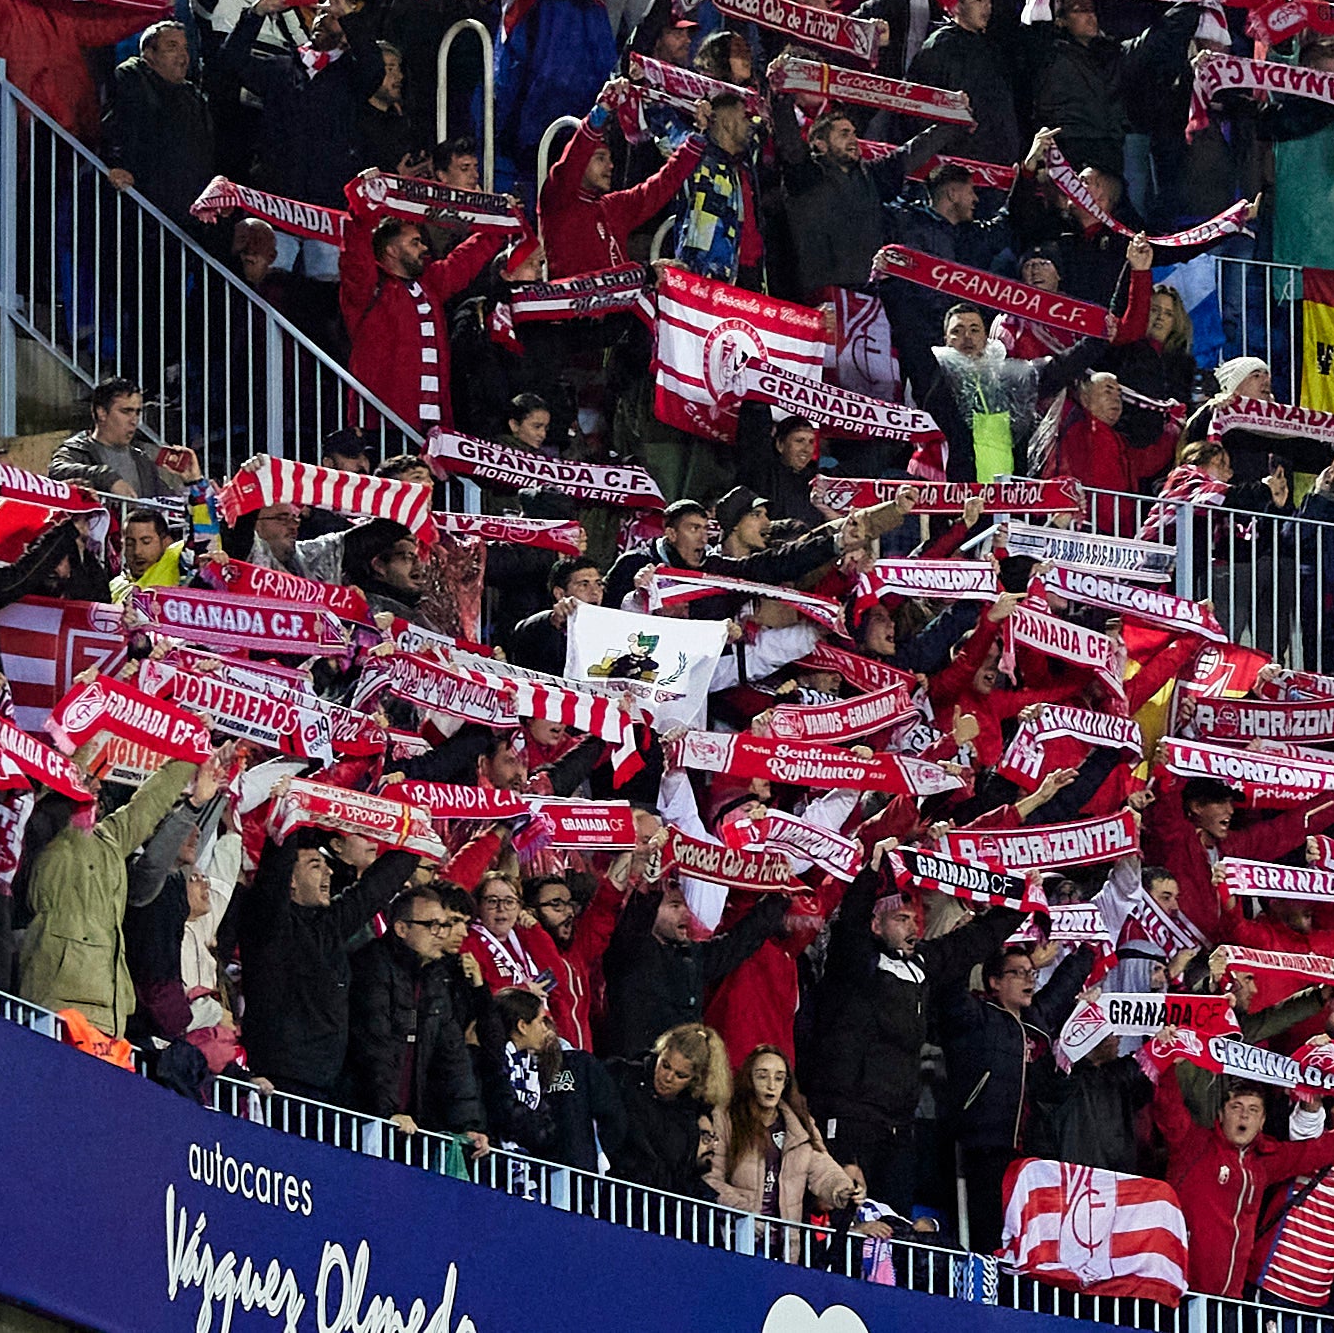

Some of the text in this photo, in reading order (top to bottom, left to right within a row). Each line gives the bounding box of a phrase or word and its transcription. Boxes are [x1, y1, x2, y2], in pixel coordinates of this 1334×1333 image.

[787, 9, 802, 30] de
[931, 265, 1088, 327] GRANADA C.F.
[759, 377, 929, 431] GRANADA C.F.
[833, 419, 863, 435] POR
[867, 425, 912, 442] VERTE
[456, 440, 654, 494] GRANADA C.F.
[580, 487, 629, 505] VERTE
[250, 569, 354, 610] GRANADA C.F.
[876, 567, 996, 593] LA HORIZONTAL
[1069, 574, 1202, 624] HORIZONTAL
[163, 599, 309, 640] GRANADA C.F.
[104, 689, 194, 745] GRANADA CF
[47, 750, 65, 776] CF
[1173, 751, 1206, 770] LA
[561, 818, 610, 833] GRANADA
[1001, 818, 1134, 867] HORIZONTAL
[916, 855, 990, 891] GRANADA
[1110, 1000, 1191, 1027] GRANADA
[189, 1142, 312, 1216] autocares
